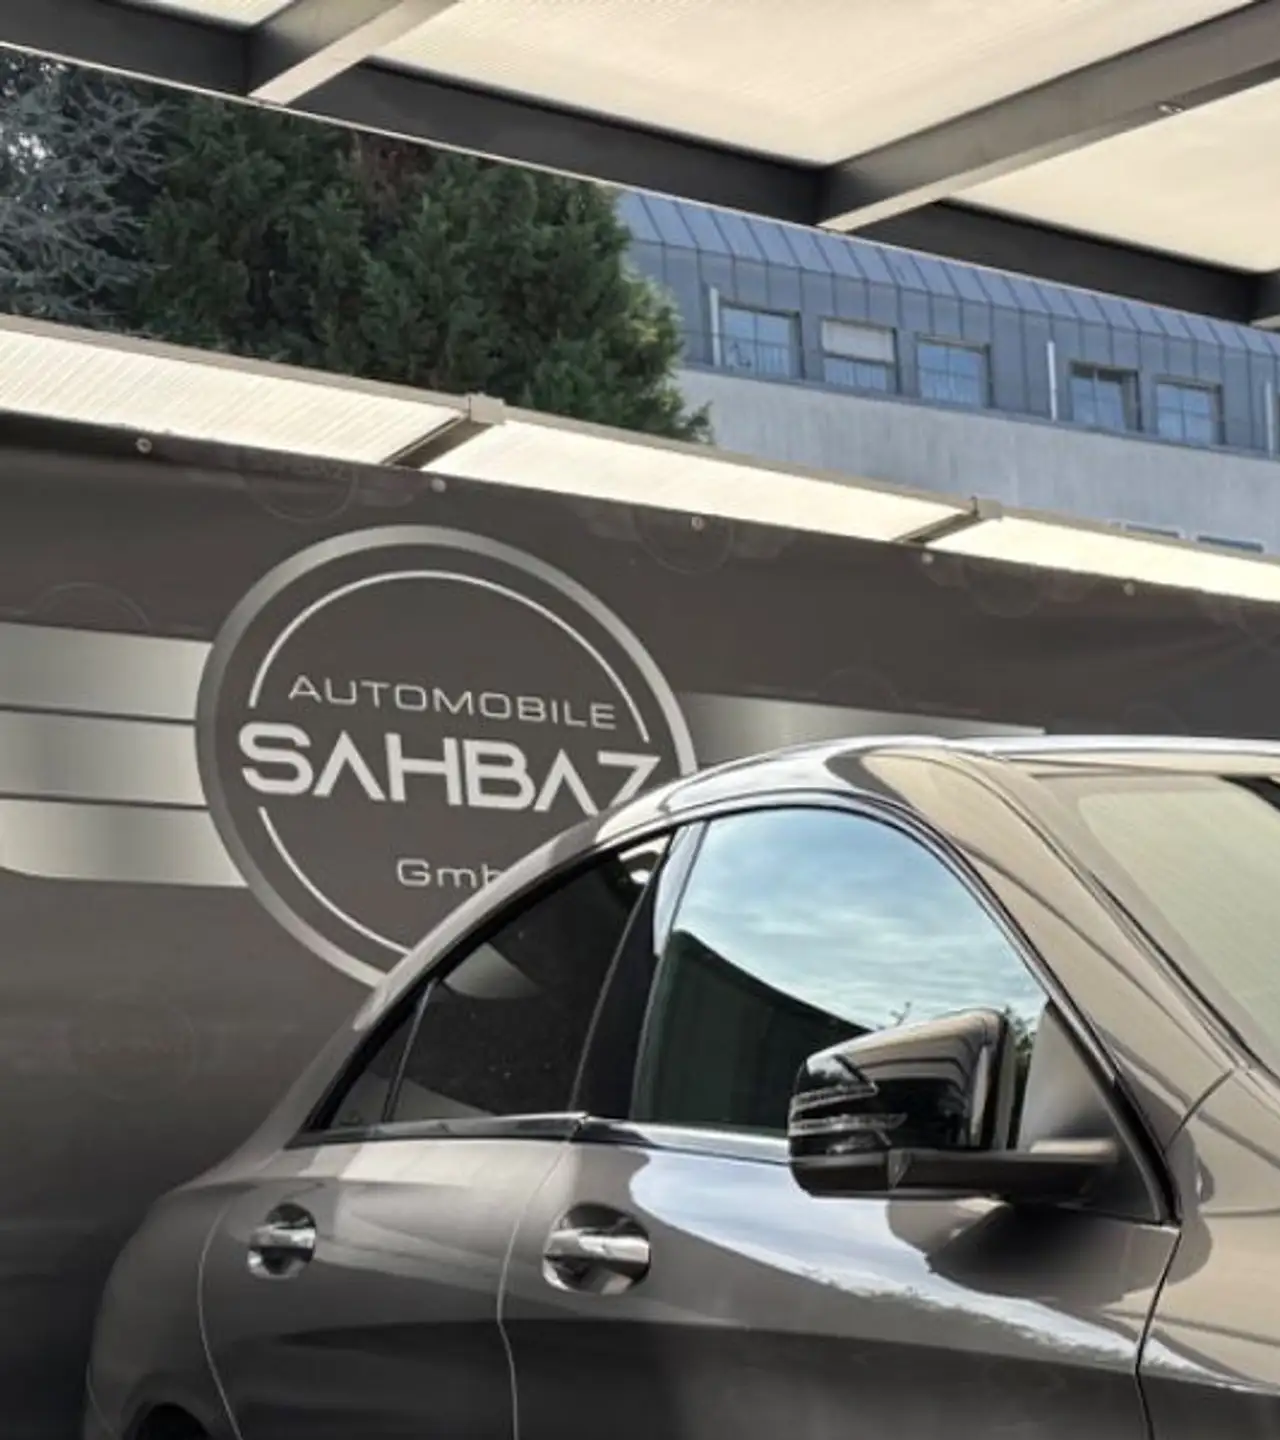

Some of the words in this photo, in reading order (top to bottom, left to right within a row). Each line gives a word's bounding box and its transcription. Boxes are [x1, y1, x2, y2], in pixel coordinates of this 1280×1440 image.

[288, 674, 616, 730] AUTOMOBILE
[238, 721, 661, 818] SAHBAZ
[396, 858, 504, 888] Gmb
